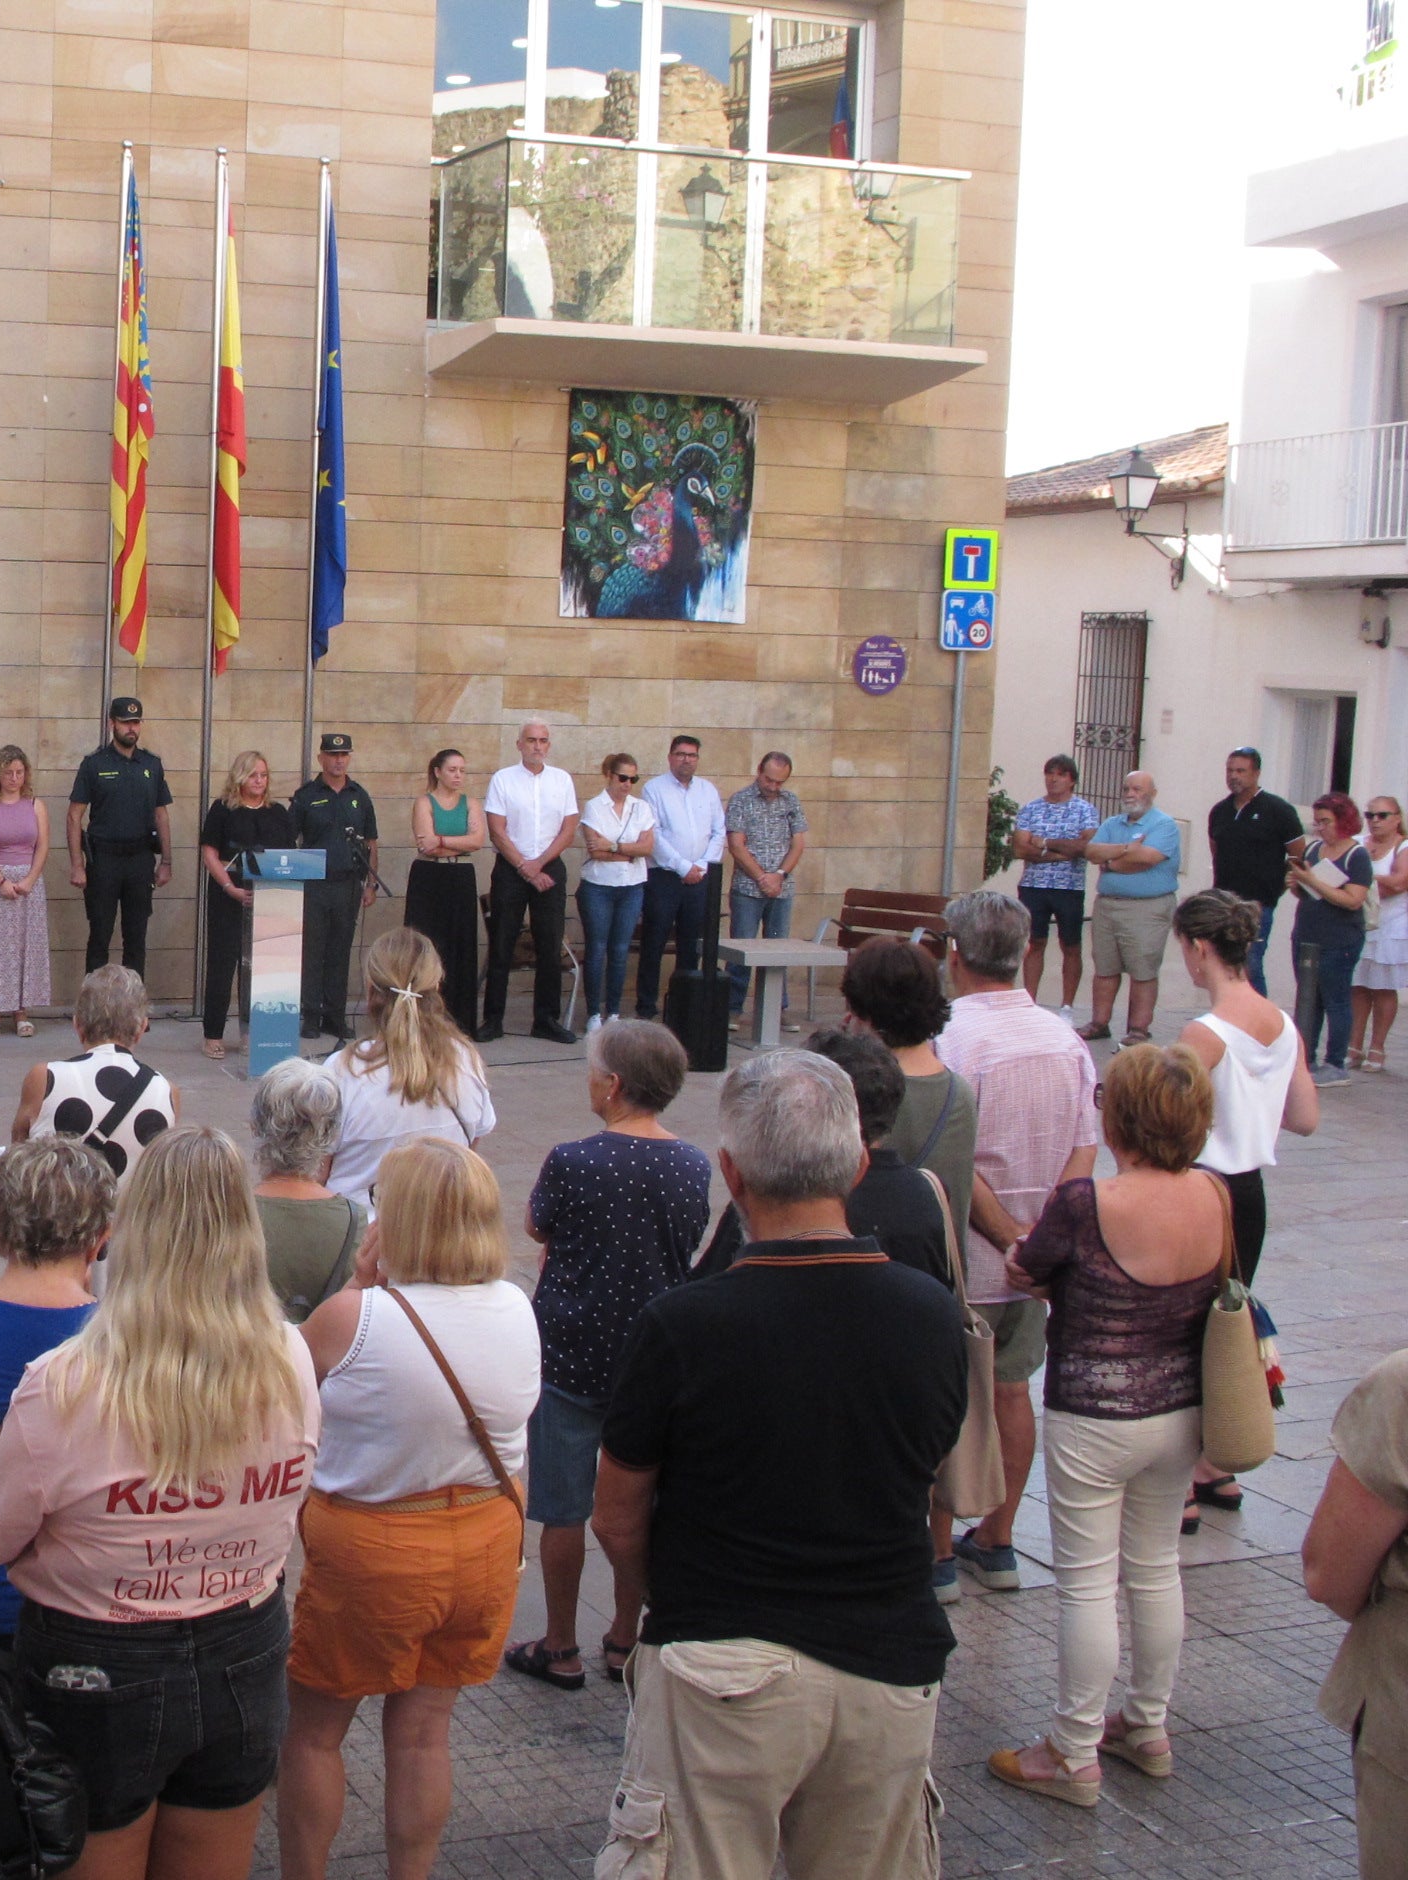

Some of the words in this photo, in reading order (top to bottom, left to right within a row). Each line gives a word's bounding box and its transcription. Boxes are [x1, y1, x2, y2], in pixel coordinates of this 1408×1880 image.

[972, 628, 986, 638] 20
[106, 1467, 226, 1515] KISS
[240, 1453, 307, 1506] ME
[144, 1537, 196, 1568] We
[202, 1538, 257, 1562] can
[113, 1569, 184, 1600] talk
[108, 1610, 128, 1621] MADE
